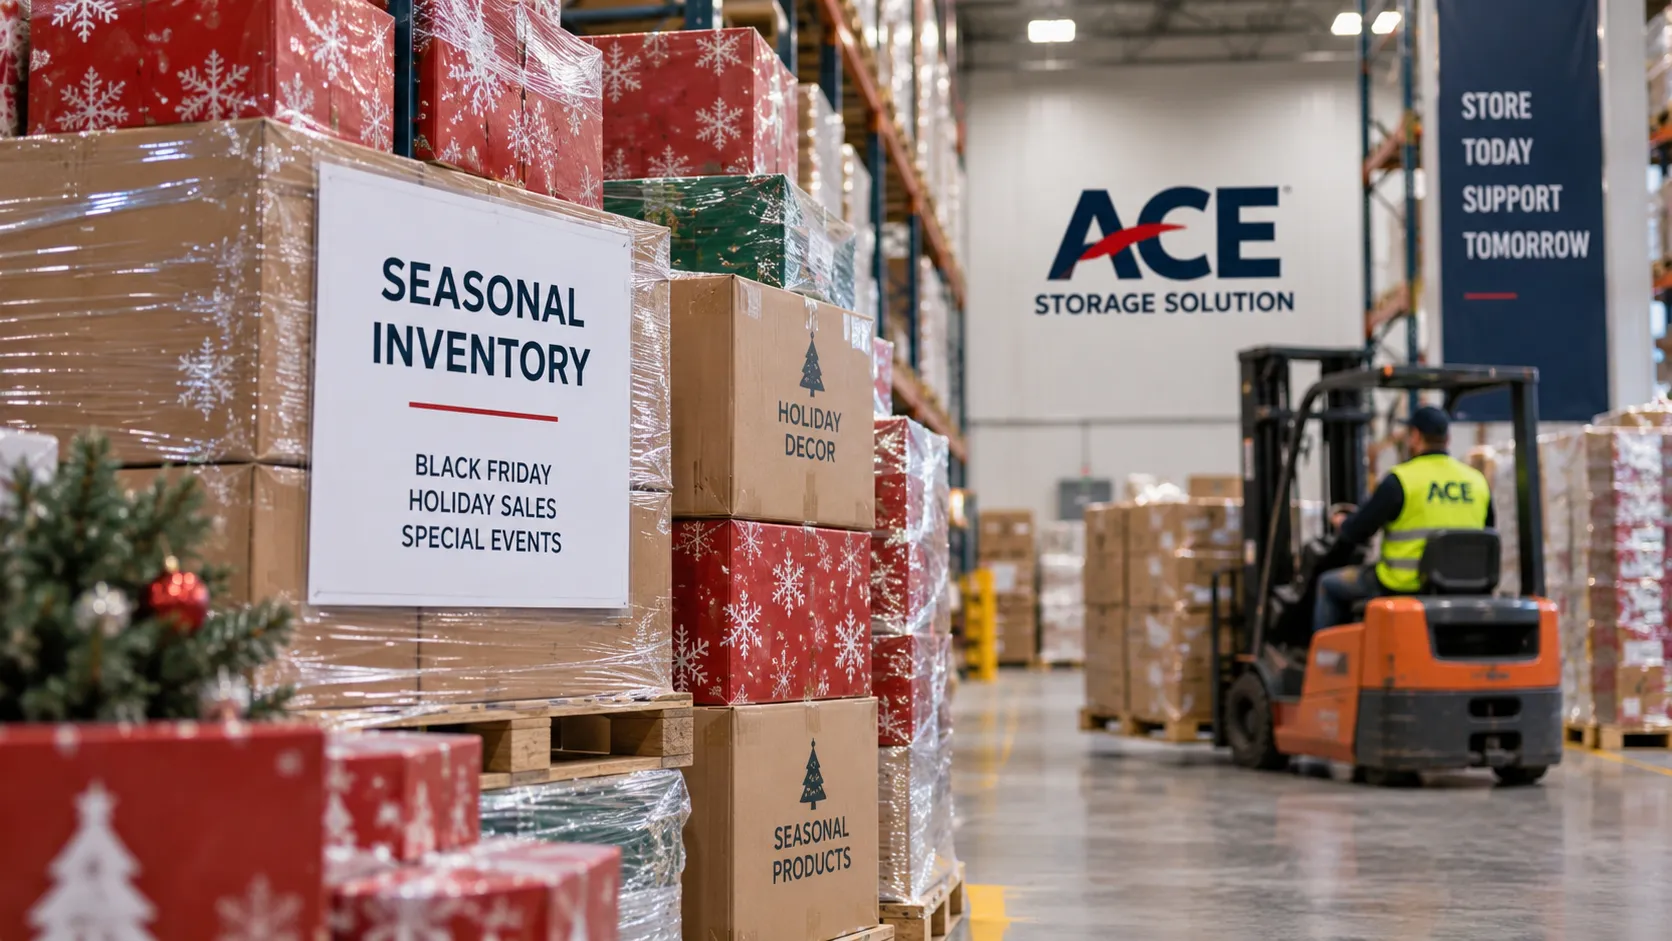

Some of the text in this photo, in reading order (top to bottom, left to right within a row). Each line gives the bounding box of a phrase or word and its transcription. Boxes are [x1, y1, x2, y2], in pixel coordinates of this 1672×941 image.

[1461, 91, 1532, 120] STORE
[1461, 137, 1533, 166] TODAY
[1462, 184, 1563, 213] SUPPORT
[1047, 186, 1282, 281] ACE
[1463, 230, 1590, 260] TOMORROW
[381, 256, 585, 328] SEASONAL
[1034, 291, 1294, 315] STORAGE SOLUTION
[373, 321, 591, 387] INVENTORY
[778, 400, 842, 433] HOLIDAY
[785, 433, 836, 463] DECOR
[415, 453, 552, 486] BLACK FRIDAY
[409, 488, 557, 520] HOLIDAY SALES
[1426, 481, 1474, 504] ACE
[401, 524, 562, 554] SPECIAL EVENTS
[773, 815, 850, 851] SEASONAL
[772, 846, 852, 885] PRODUCTS
